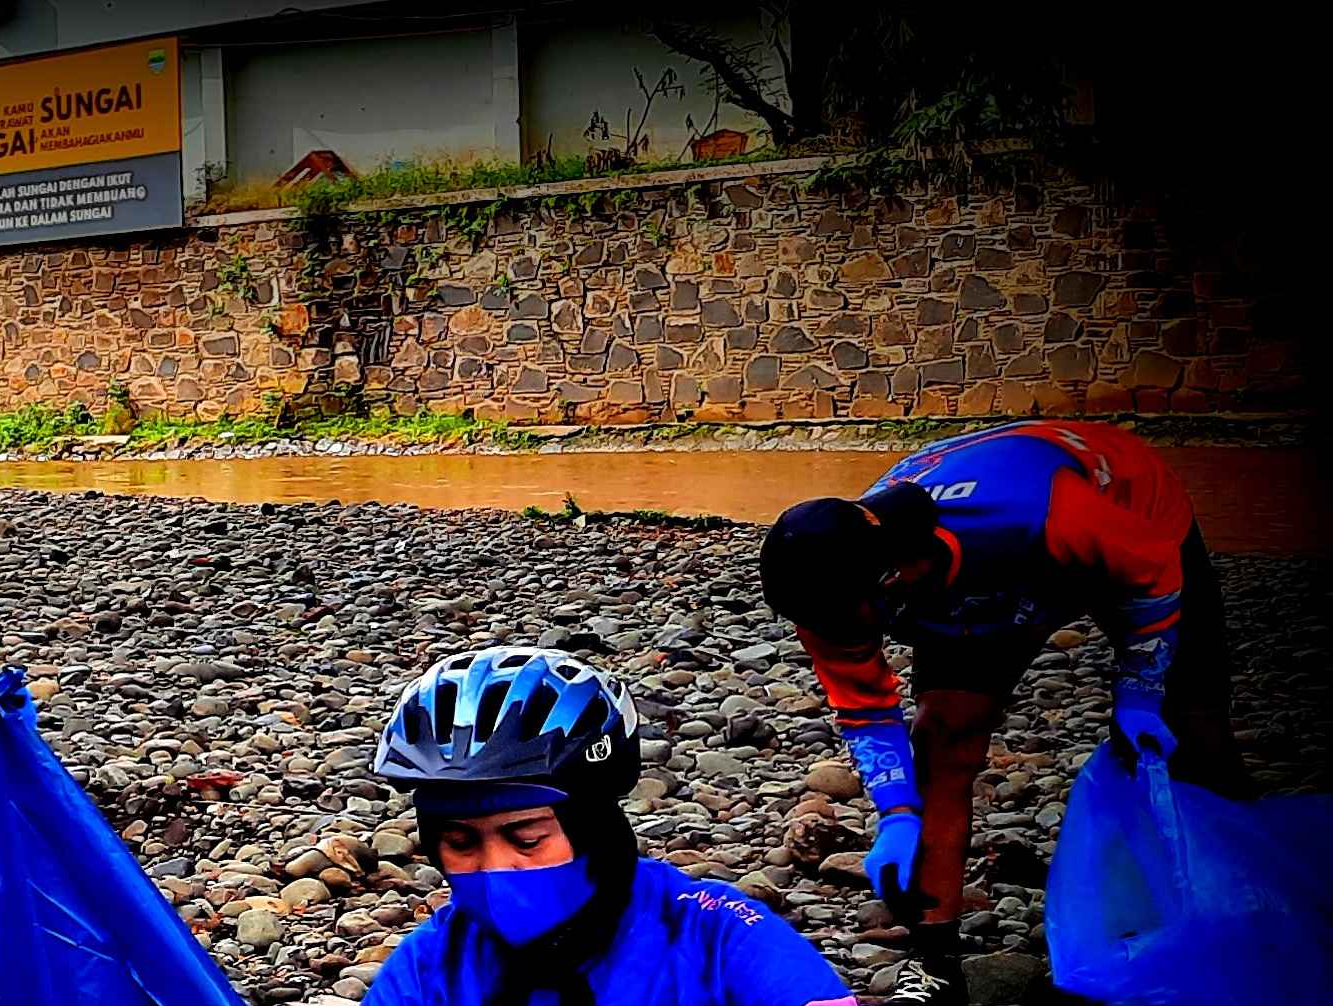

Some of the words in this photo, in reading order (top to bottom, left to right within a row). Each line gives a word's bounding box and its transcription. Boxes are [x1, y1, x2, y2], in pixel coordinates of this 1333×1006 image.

[4, 103, 34, 115] KAMU
[40, 82, 142, 123] SUNGAI
[41, 126, 71, 138] AKAN
[18, 182, 58, 197] SUNGAI
[59, 175, 105, 191] DENGAN
[107, 173, 132, 186] IKUT
[14, 199, 37, 212] DAN
[40, 194, 74, 210] TIDAK
[77, 186, 146, 205] MEMBUANG
[16, 215, 29, 228] KE
[31, 210, 68, 226] DALAM
[70, 206, 112, 221] SUNGAI
